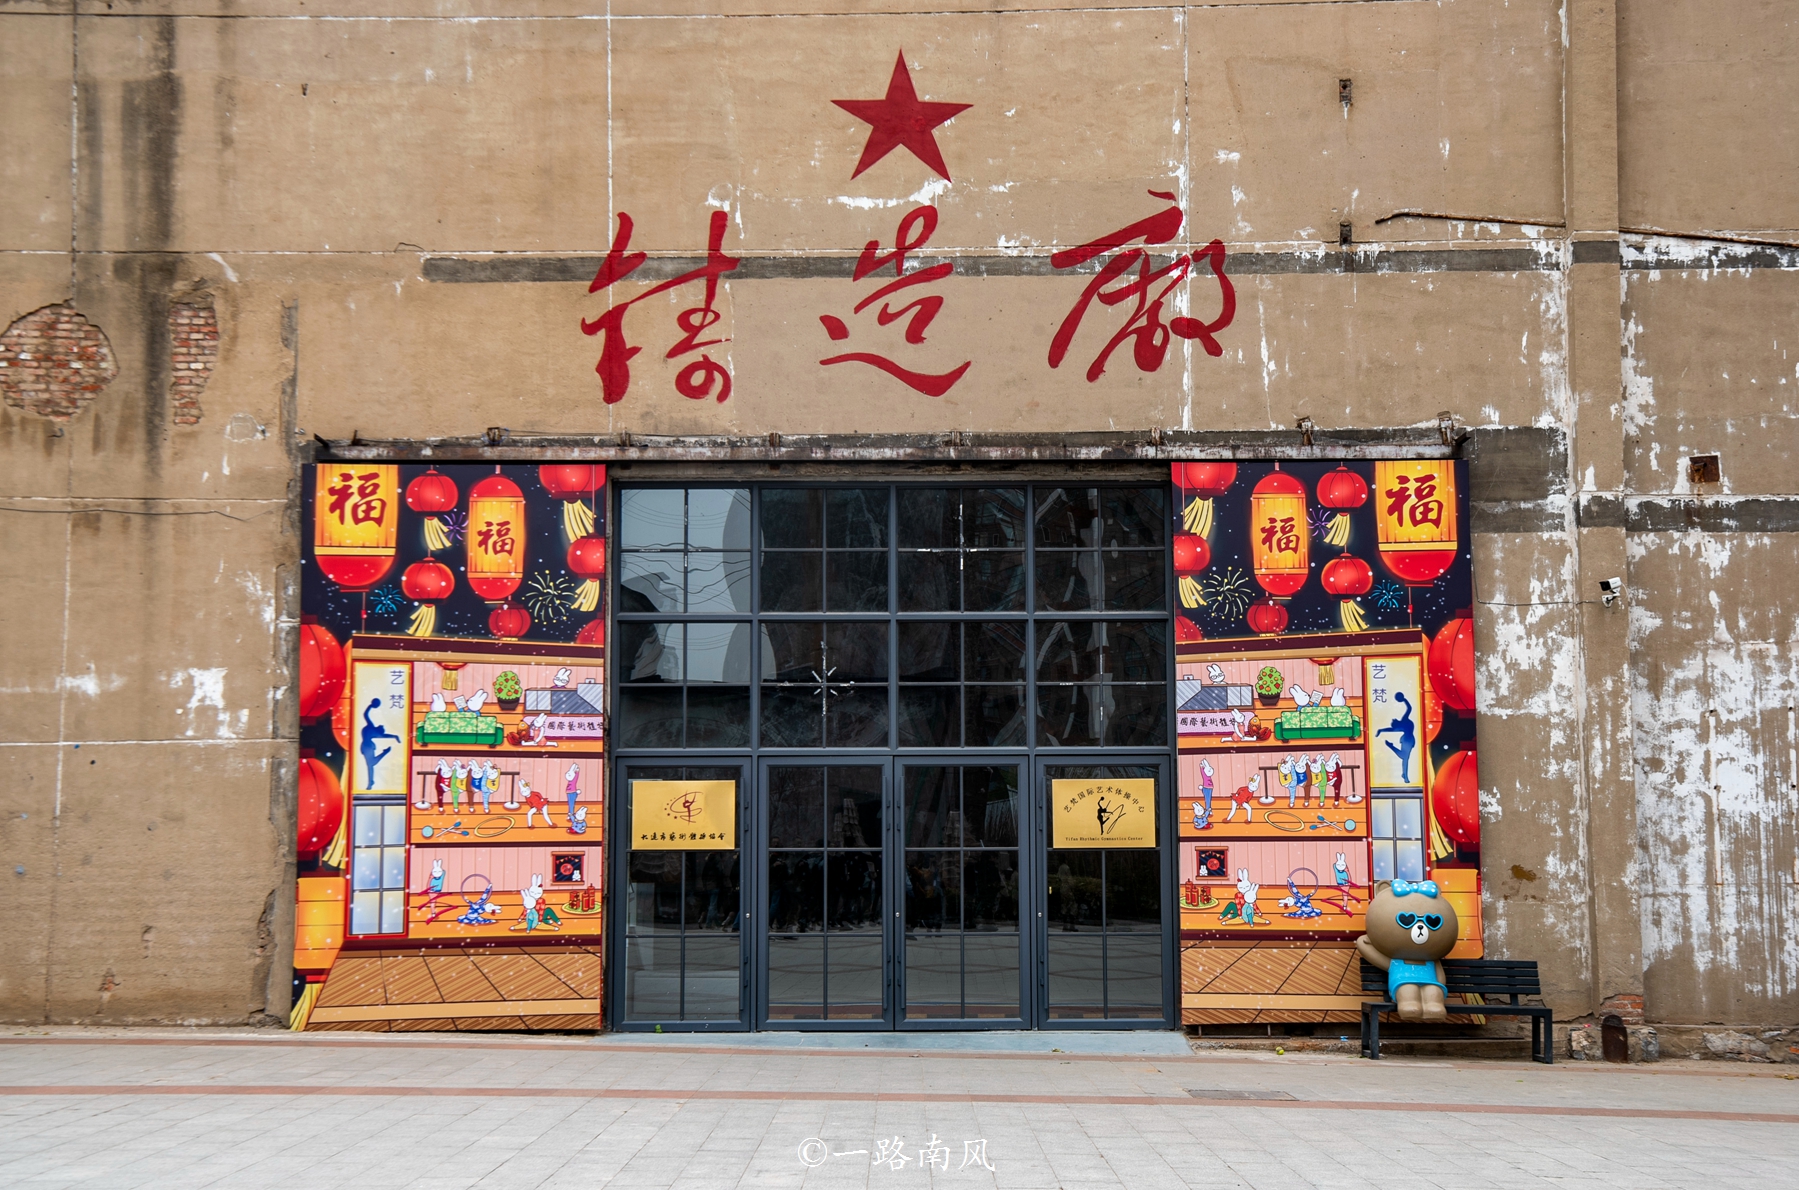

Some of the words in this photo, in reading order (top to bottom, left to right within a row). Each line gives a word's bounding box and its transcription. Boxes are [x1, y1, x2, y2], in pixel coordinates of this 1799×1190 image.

[328, 471, 387, 528] 福
[1385, 473, 1444, 529] 福
[477, 520, 516, 557] 福
[1260, 516, 1301, 555] 福
[389, 669, 405, 709] 艺梵
[1371, 663, 1387, 703] 艺梵
[1063, 785, 1145, 813] 艺梵国际艺术体操中心
